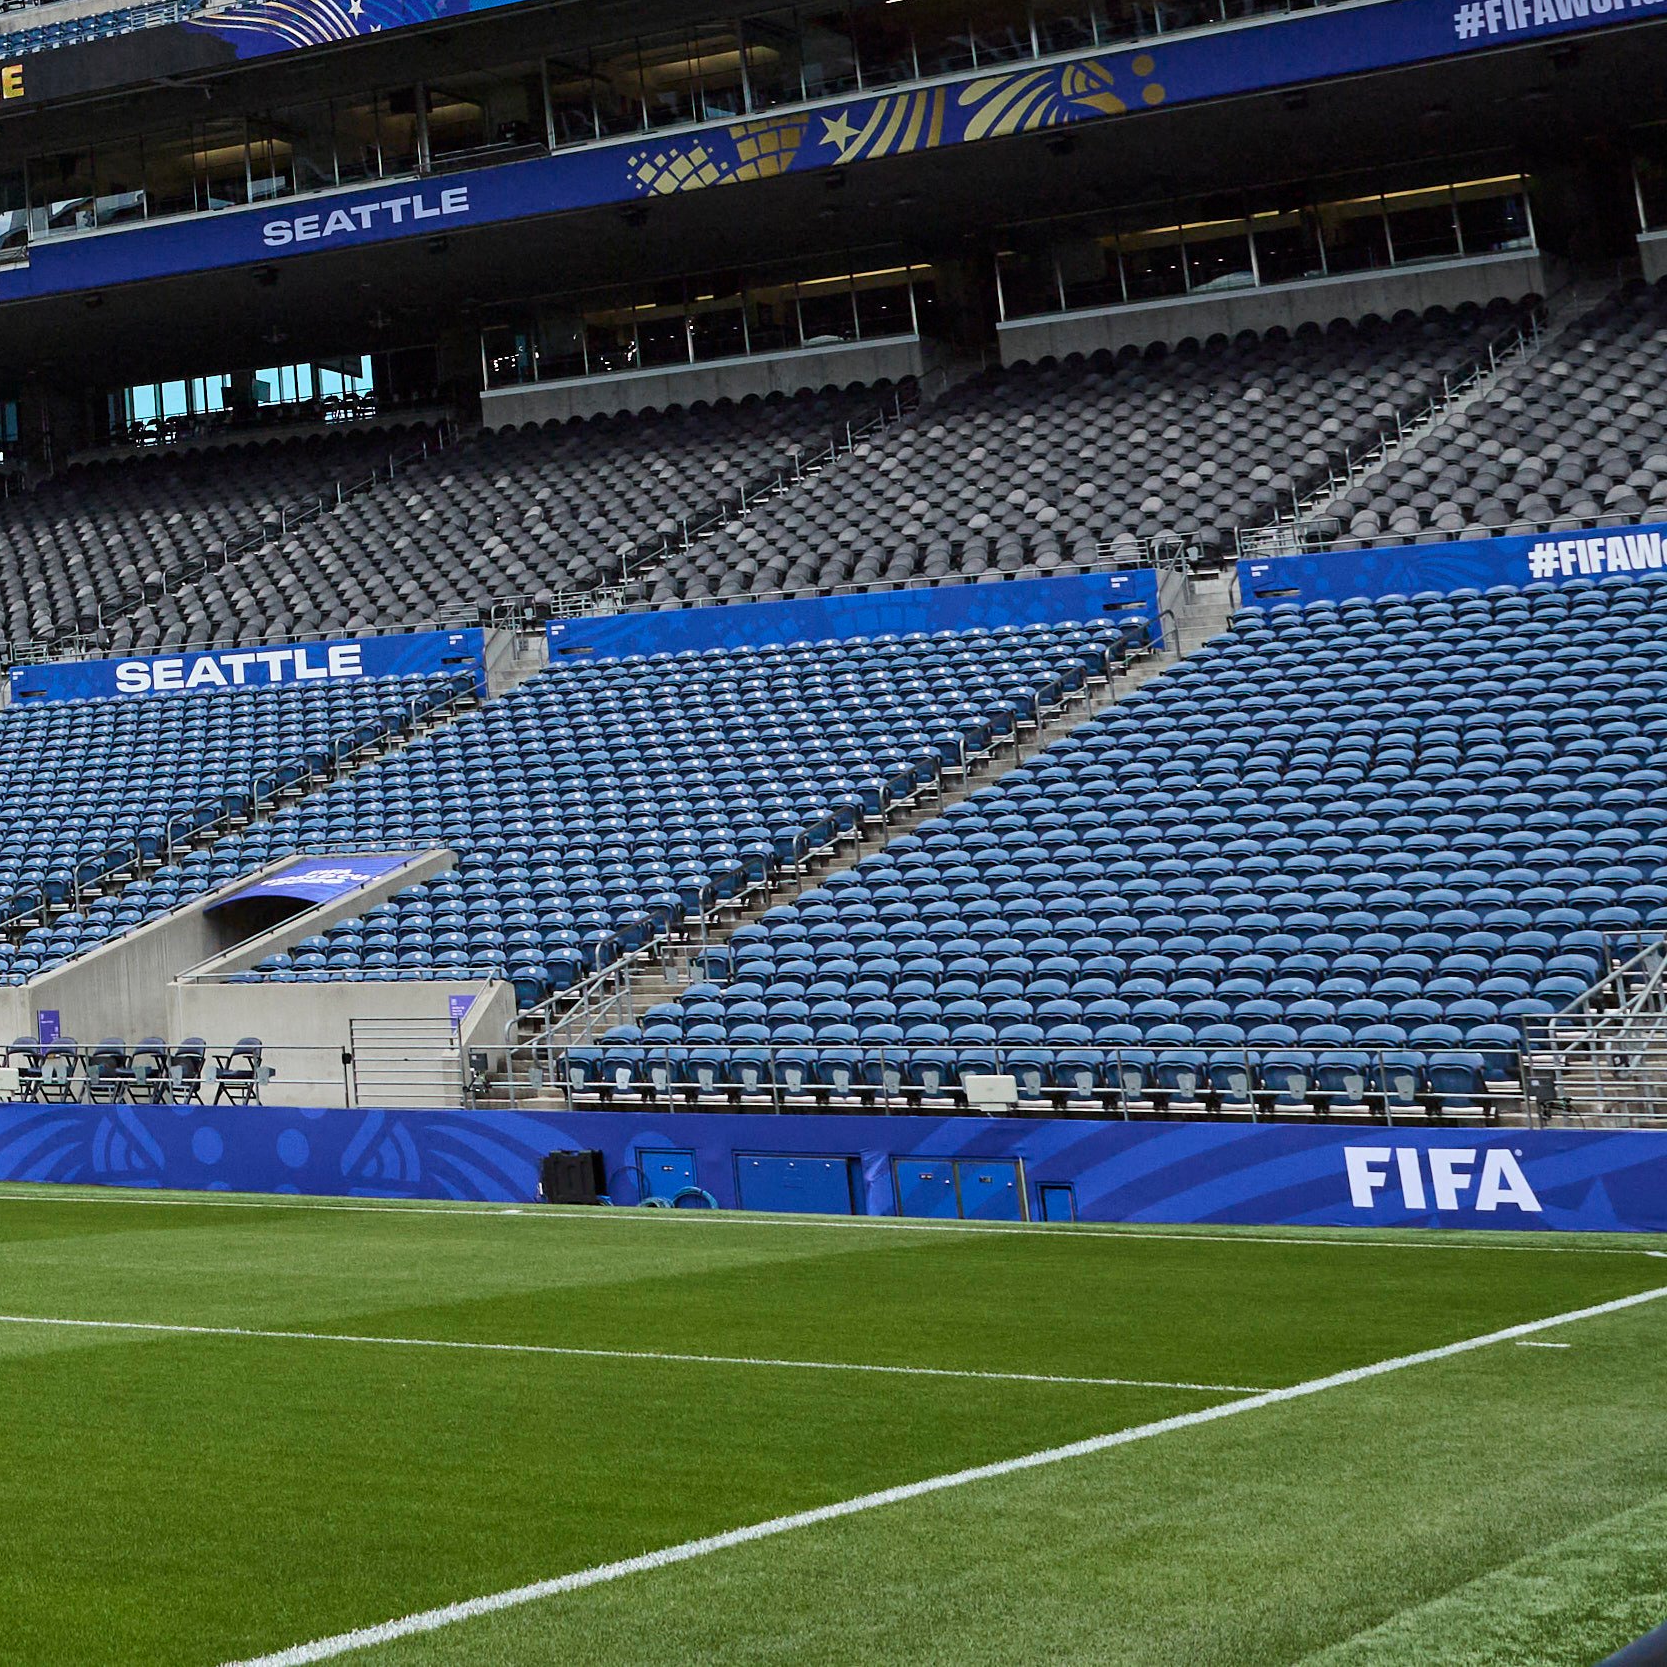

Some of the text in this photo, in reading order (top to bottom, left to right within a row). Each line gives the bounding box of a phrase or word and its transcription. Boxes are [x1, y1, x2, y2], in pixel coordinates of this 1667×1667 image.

[263, 186, 470, 247] SEATTLE
[1527, 533, 1667, 578] #FIFAW
[115, 644, 363, 693] SEATTLE
[1344, 1146, 1543, 1212] FIFA
